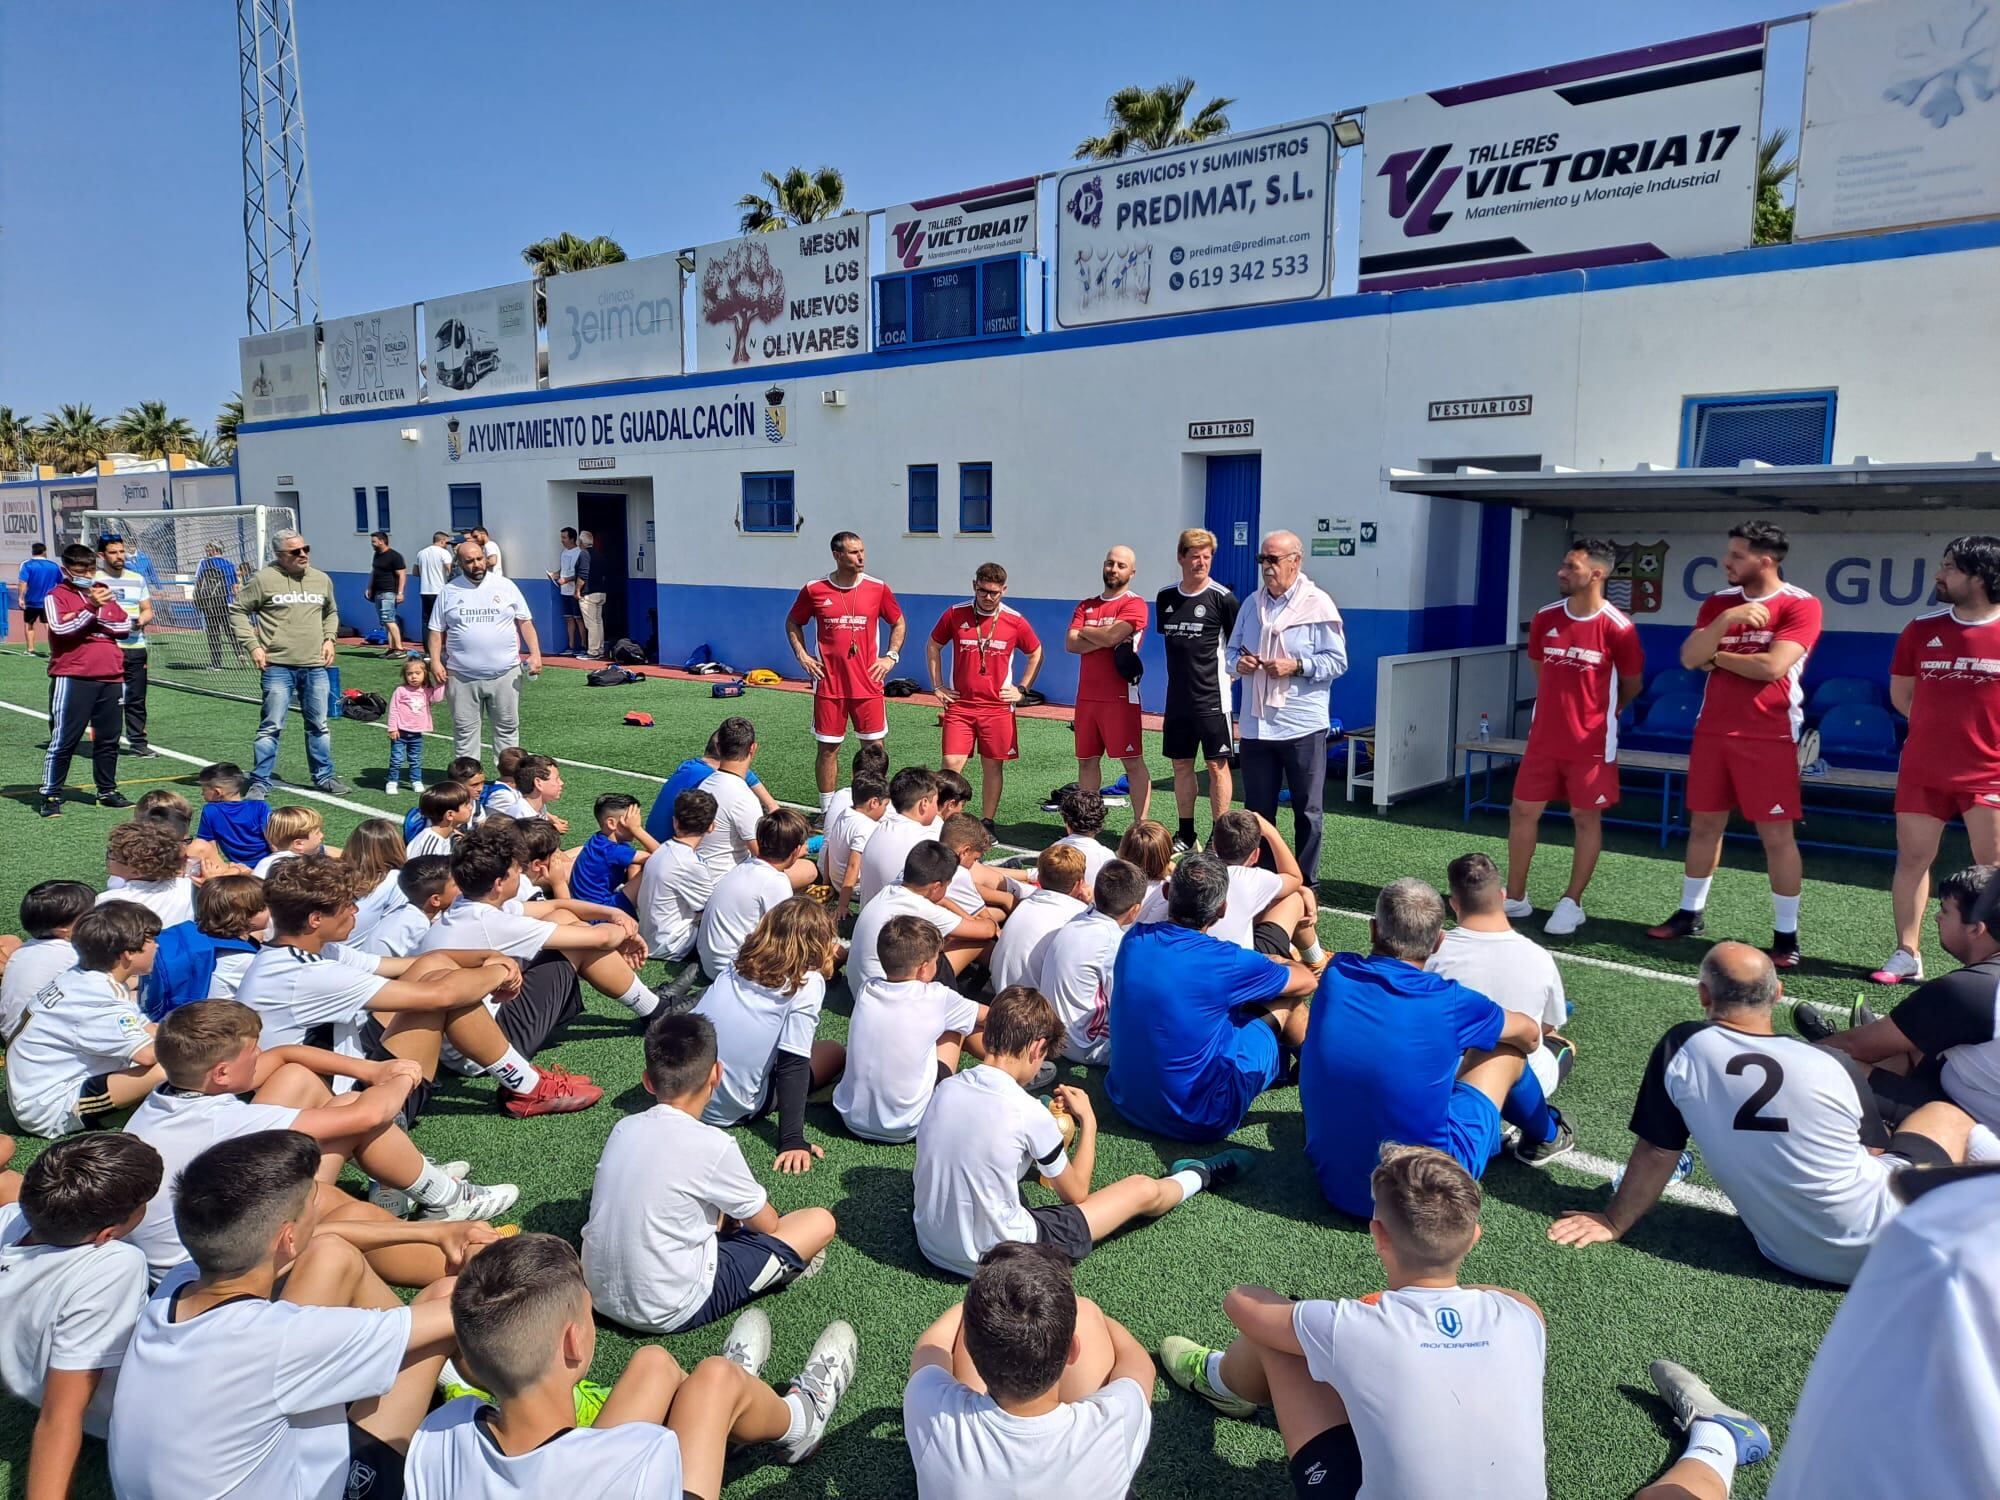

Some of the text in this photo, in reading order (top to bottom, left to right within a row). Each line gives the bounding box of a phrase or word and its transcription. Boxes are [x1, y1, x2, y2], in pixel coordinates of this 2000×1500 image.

[1466, 125, 1741, 200] VICTORIA 17
[1468, 133, 1559, 165] TALLERES
[1116, 137, 1309, 190] SERVICIOS Y SUMINISTROS
[1117, 171, 1313, 231] PREDIMAT, S.L.
[1465, 170, 1721, 220] Mantenimiento y Montaje Industrial
[927, 215, 1029, 249] VICTORIA 17
[928, 215, 963, 231] TALLERES
[800, 227, 859, 257] MESON
[1189, 231, 1311, 259] predimat@predimat.com
[825, 260, 859, 284] LOS
[933, 274, 959, 288] TIEMPO
[1189, 253, 1309, 289] 619 342 533
[790, 292, 859, 321] NUEVOS
[339, 388, 405, 406] GRUPO LA CUEVA
[1434, 400, 1527, 416] VESTUARIOS
[468, 394, 755, 453] AYUNTAMIENTO DE GUADALCACÍN
[1193, 423, 1250, 436] ARBITROS
[3, 515, 38, 534] LOZANO
[271, 590, 326, 605] adidas
[459, 607, 501, 616] Emirates
[496, 1067, 524, 1089] FILA
[1725, 1053, 1789, 1132] 2
[1420, 1340, 1489, 1349] MONDRAKER
